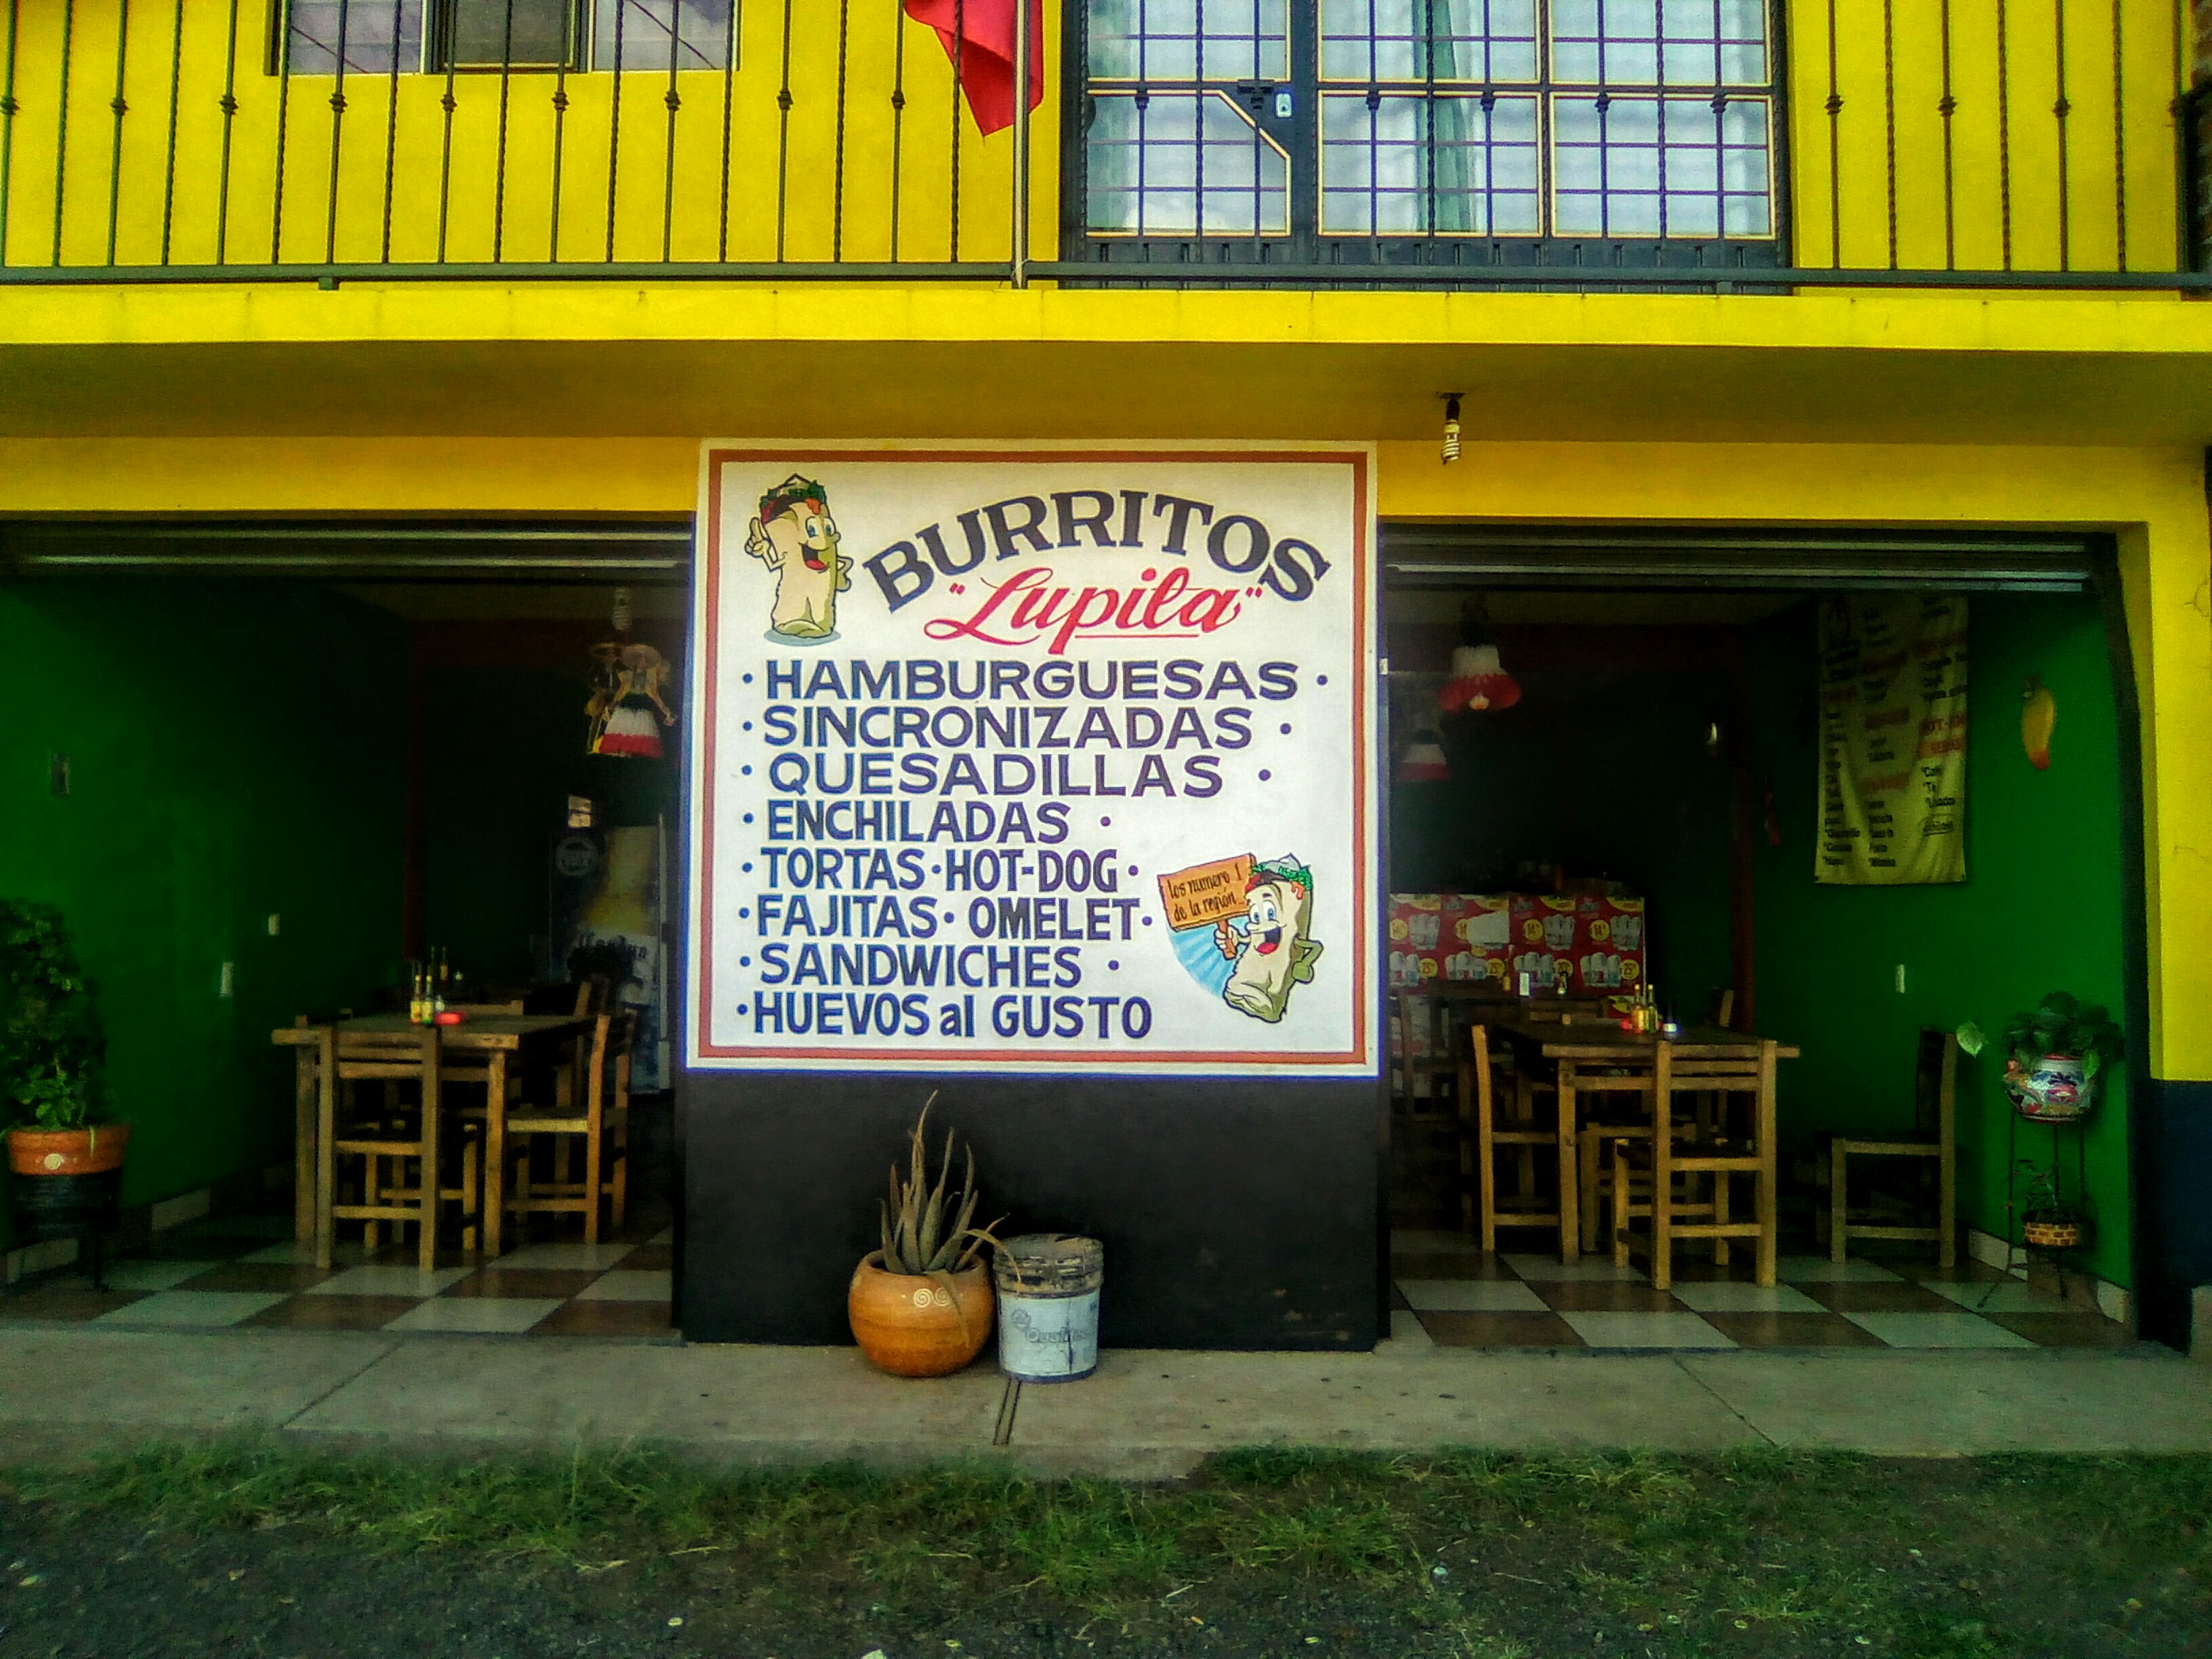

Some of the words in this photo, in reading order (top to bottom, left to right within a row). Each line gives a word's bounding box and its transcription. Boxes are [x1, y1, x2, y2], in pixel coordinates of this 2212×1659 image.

[862, 489, 1332, 613] BURRITOS
[766, 659, 1298, 701] HAMBURGUESAS
[763, 705, 1252, 750] SINCRONIZADAS
[769, 752, 1223, 798] QUESADILLAS
[768, 799, 1071, 844] ENCHILADAS
[760, 847, 926, 890] TORTAS
[945, 848, 1118, 893] HOT-DOG
[1187, 870, 1231, 895] numero
[758, 894, 938, 939] FAJITAS
[968, 896, 1141, 941] OMELET
[1173, 903, 1188, 923] de
[1187, 898, 1202, 918] la
[760, 942, 1082, 989] SANDWICHES
[754, 991, 930, 1037] HUEVOS
[939, 995, 975, 1038] al
[991, 995, 1152, 1040] GUSTO
